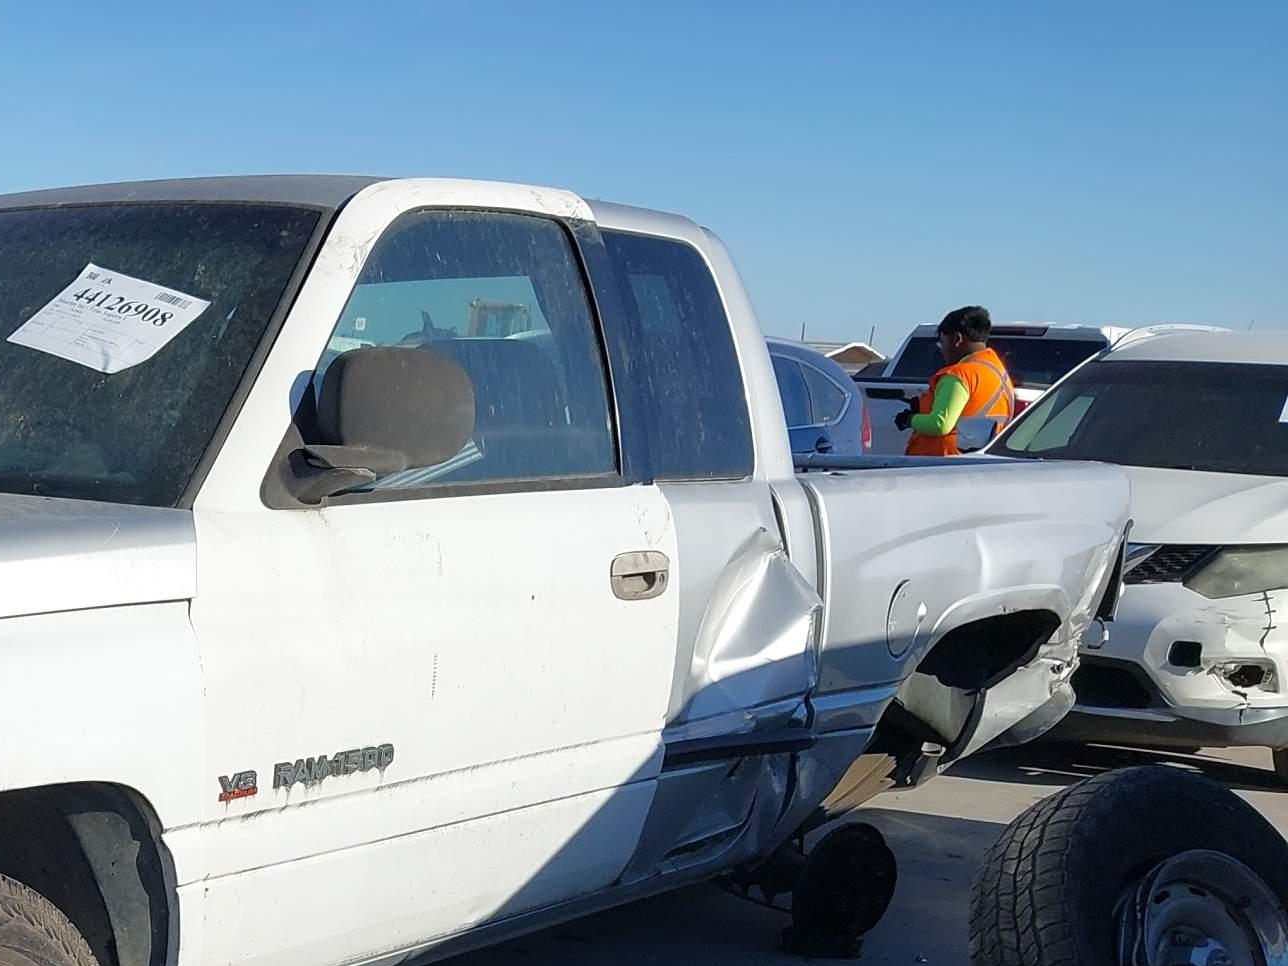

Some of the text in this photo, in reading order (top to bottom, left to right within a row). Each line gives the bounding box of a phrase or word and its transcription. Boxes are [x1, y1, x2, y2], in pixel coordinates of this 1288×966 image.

[73, 288, 174, 326] 44126908
[273, 743, 394, 788] RAM 1500
